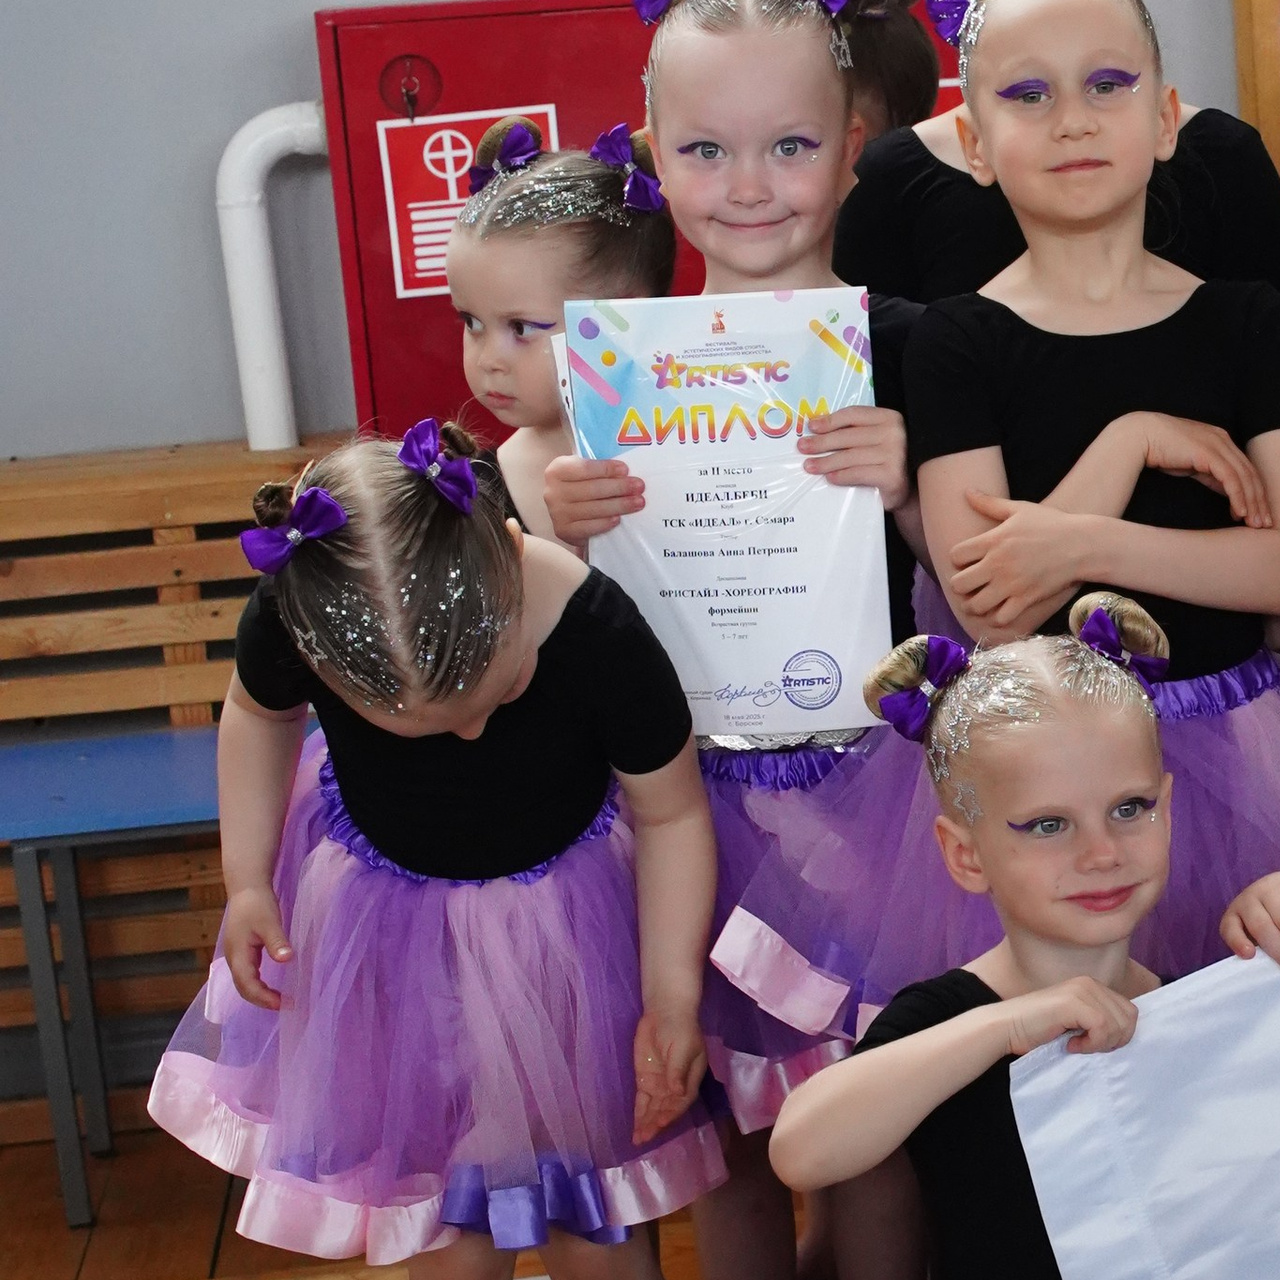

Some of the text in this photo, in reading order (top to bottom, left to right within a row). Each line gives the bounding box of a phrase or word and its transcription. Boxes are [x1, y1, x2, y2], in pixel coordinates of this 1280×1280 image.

[651, 354, 790, 389] ARTISTIC
[616, 396, 832, 446] ДИПЛОМ
[698, 468, 708, 476] за
[662, 519, 686, 528] ТСК
[688, 517, 741, 529] «ИДЕАЛ»
[663, 546, 798, 558] Балашова Анна Петровна
[659, 587, 719, 599] ФРИСТАЙЛ
[781, 675, 831, 687] ARTISTIC
